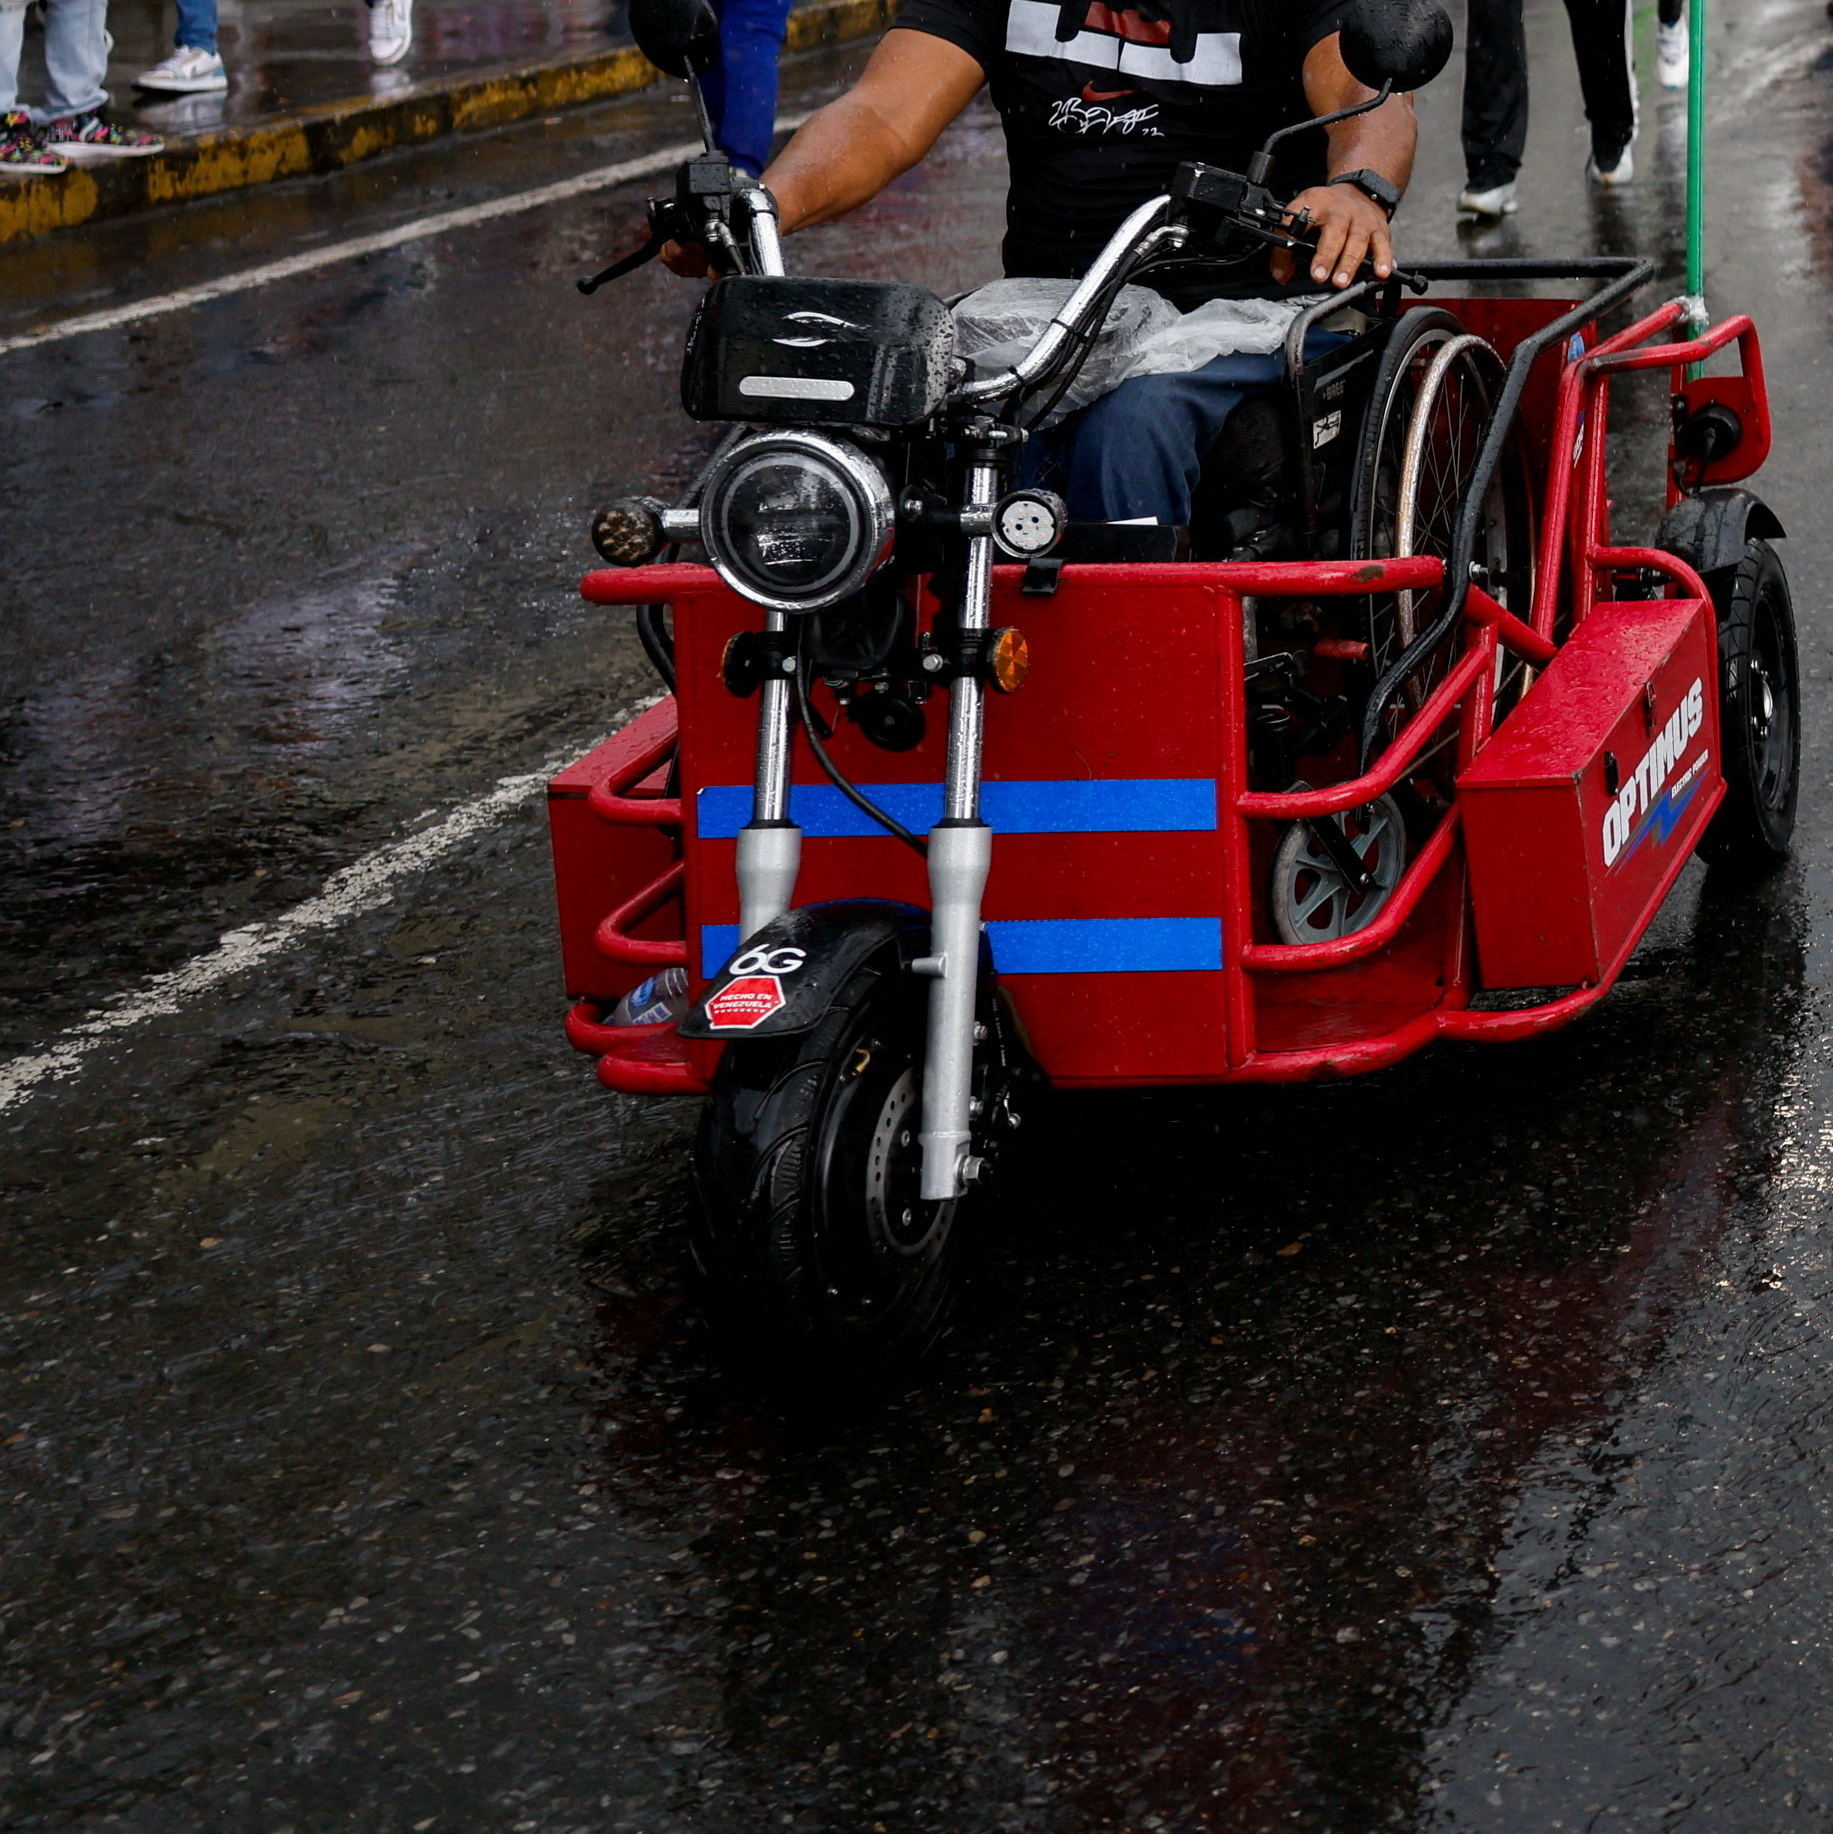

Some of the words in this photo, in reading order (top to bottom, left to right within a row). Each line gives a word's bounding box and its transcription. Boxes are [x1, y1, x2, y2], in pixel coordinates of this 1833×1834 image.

[1602, 676, 1704, 868] OPTIMUS
[729, 943, 807, 975] 6G
[712, 1000, 772, 1010] VENEZUELA
[719, 992, 755, 1002] HECHO
[756, 992, 772, 1001] EN
